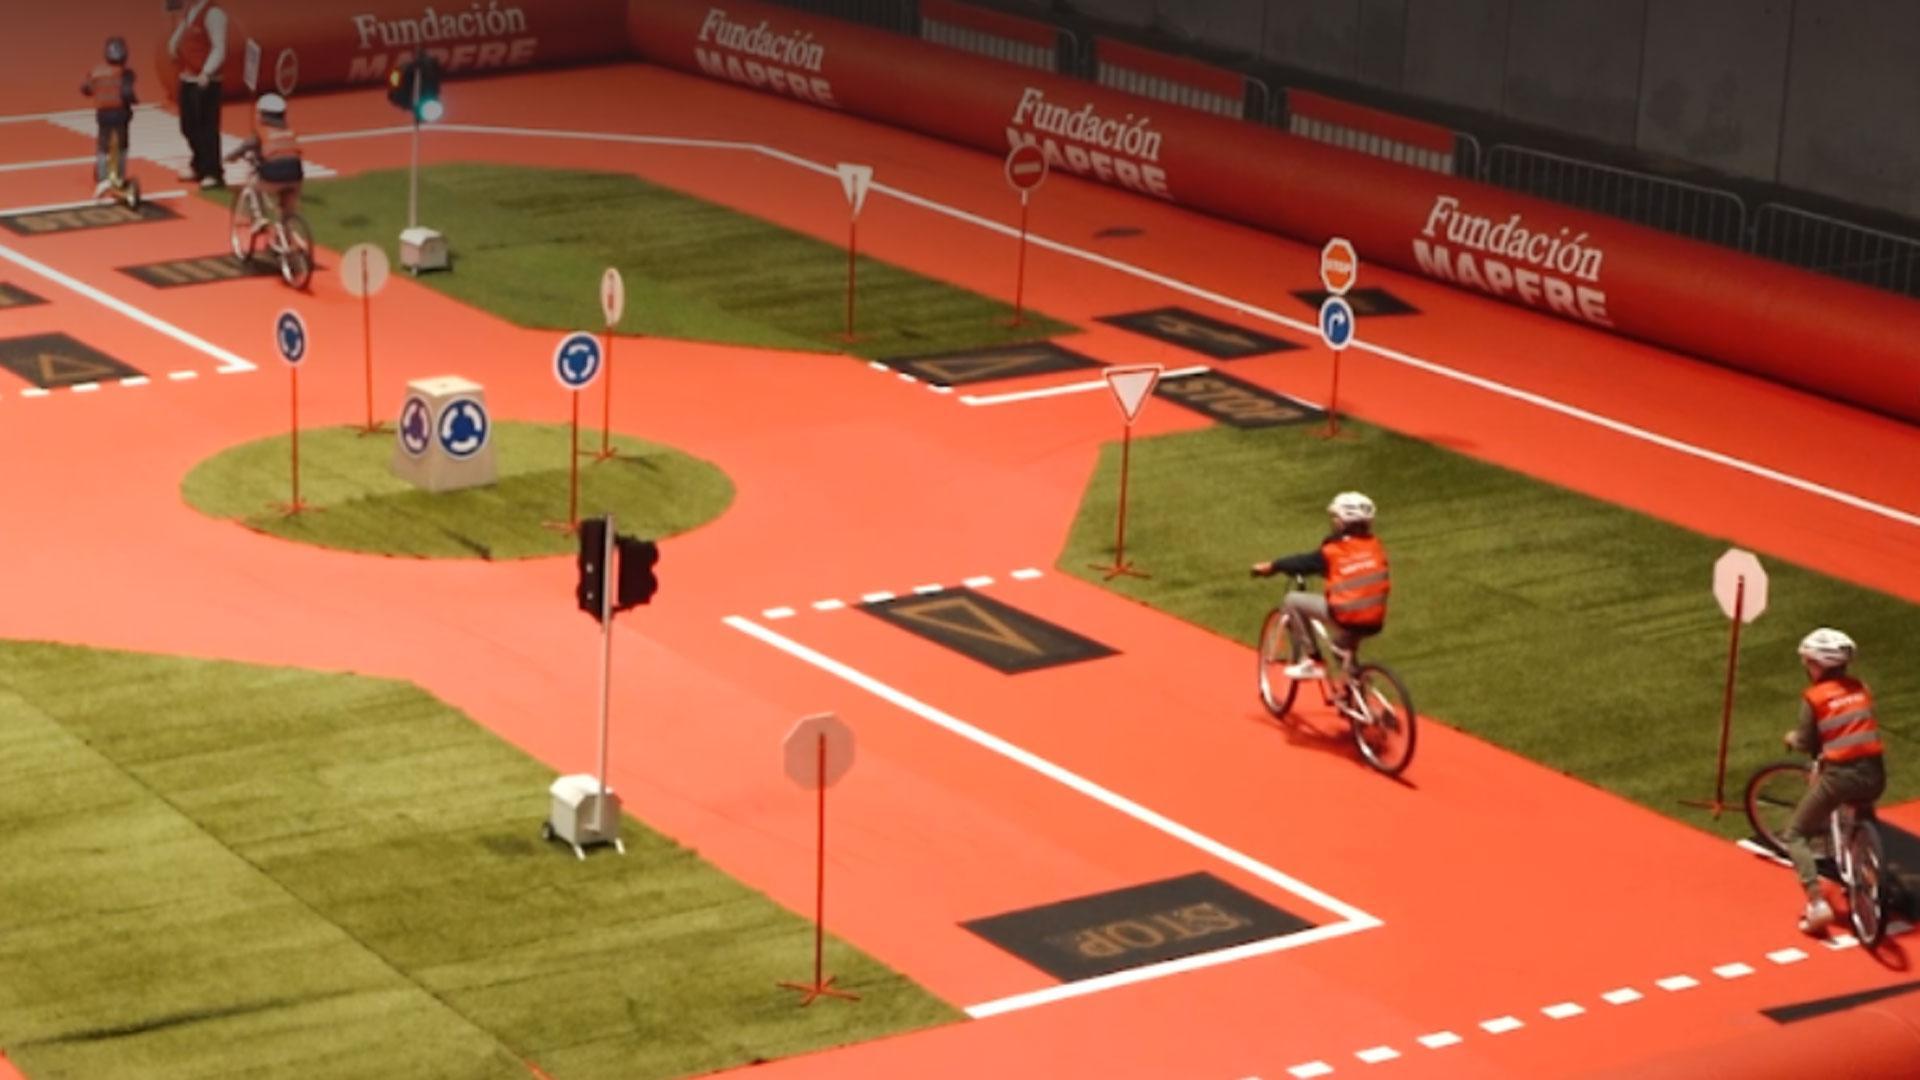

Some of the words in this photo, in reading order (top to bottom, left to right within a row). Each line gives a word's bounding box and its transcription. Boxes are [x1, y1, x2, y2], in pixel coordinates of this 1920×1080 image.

[353, 1, 528, 49] Fundación
[698, 8, 825, 72] Fundación
[1012, 86, 1162, 161] Fundación
[1422, 195, 1603, 282] Fundación
[1412, 239, 1614, 326] MAPFRE
[1078, 901, 1242, 957] STOP
